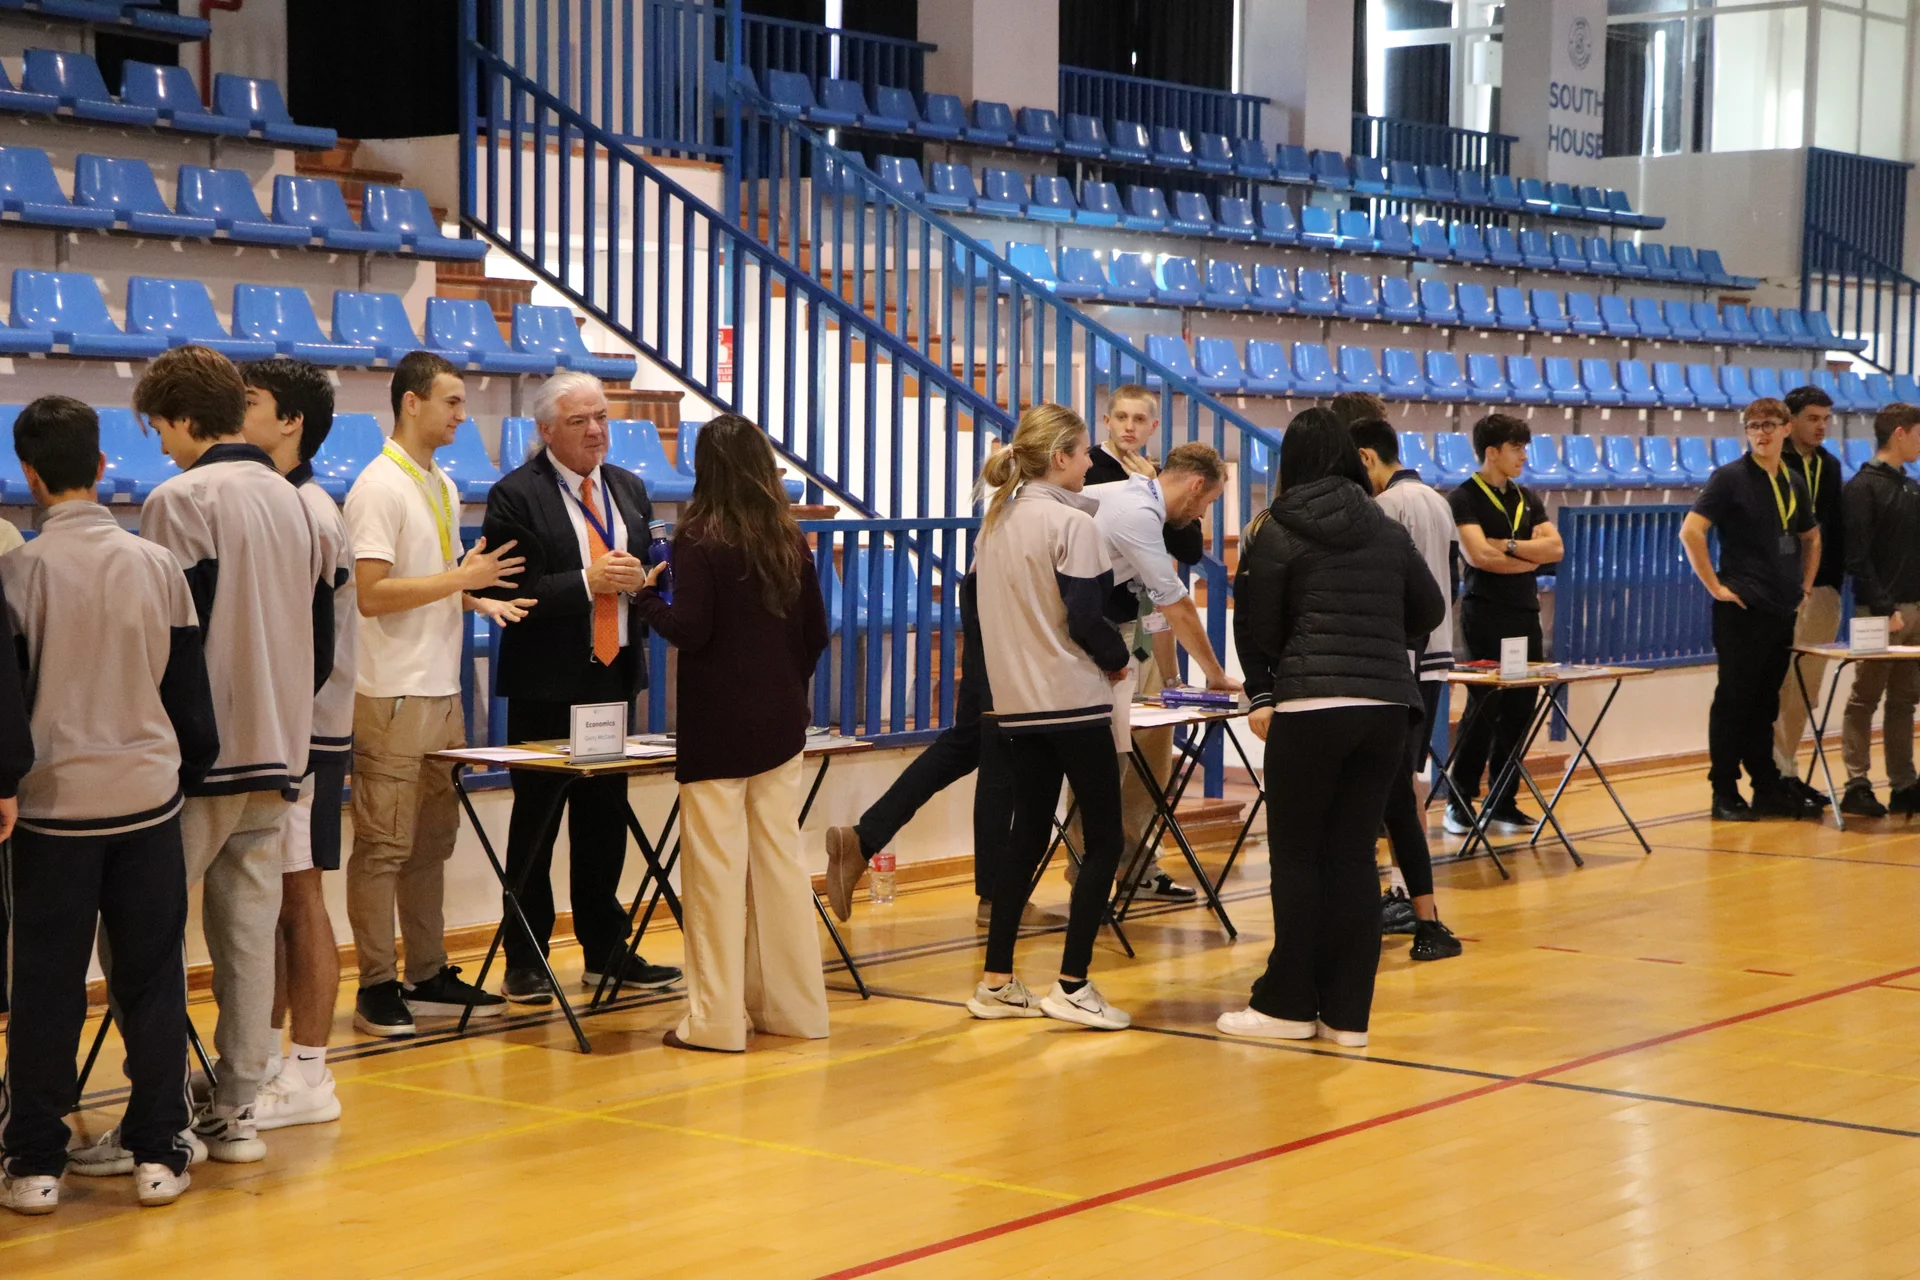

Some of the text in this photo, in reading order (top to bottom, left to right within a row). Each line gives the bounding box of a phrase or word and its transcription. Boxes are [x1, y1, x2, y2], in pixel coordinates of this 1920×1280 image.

[1549, 81, 1604, 117] SOUTH
[1548, 124, 1604, 160] HOUSE
[397, 456, 420, 478] PEDRO
[585, 720, 616, 728] Economics
